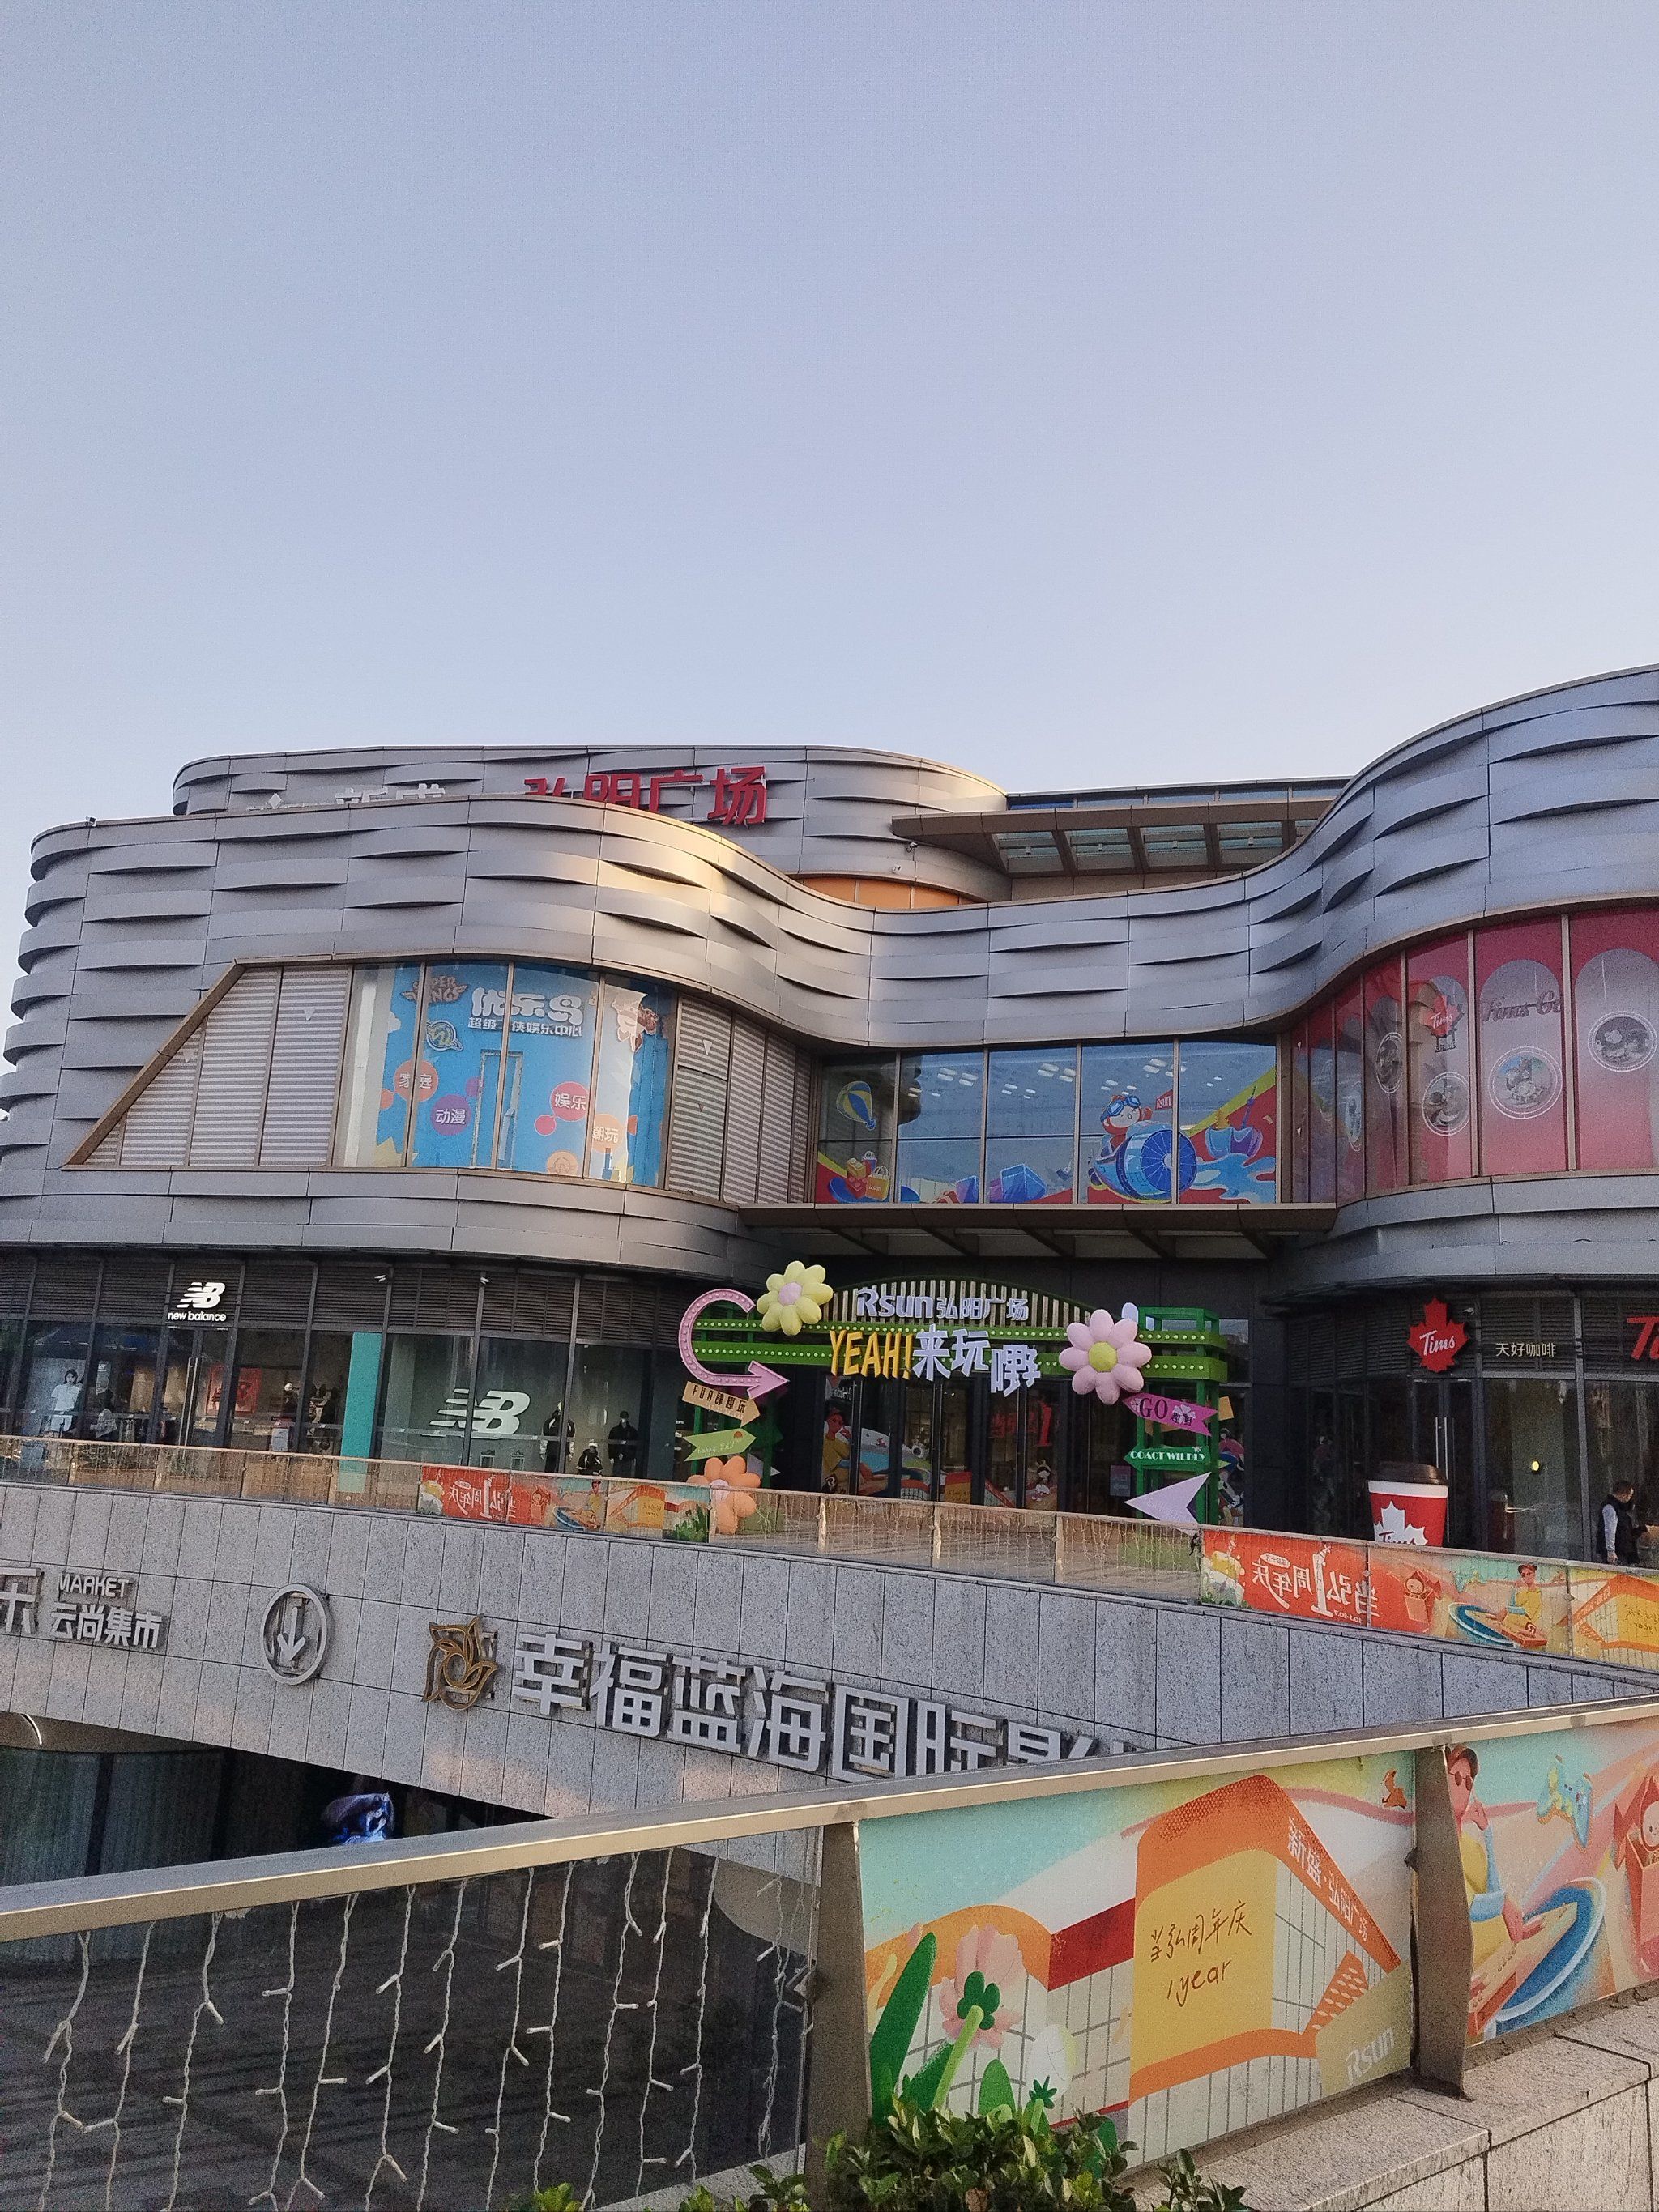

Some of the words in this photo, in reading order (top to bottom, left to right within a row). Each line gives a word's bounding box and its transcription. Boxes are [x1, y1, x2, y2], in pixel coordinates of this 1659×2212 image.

[467, 1016, 583, 1038] 超级侠娱乐中心
[554, 1091, 586, 1111] 娱乐
[435, 1107, 466, 1125] 动漫
[856, 1288, 933, 1319] Rsun
[936, 1296, 1030, 1321] 弘阳广场
[167, 1311, 187, 1321] new
[187, 1311, 227, 1322] balance
[830, 1329, 914, 1380] YEAH!
[1419, 1330, 1456, 1357] Tims
[1495, 1342, 1556, 1357] 天好咖啡
[1139, 1397, 1169, 1420] GO
[1166, 1452, 1206, 1461] WILDLY
[59, 1573, 130, 1597] MARKET
[51, 1601, 162, 1649] 云尚集市
[1176, 1960, 1232, 2007] year
[1346, 2027, 1394, 2087] Rsun
